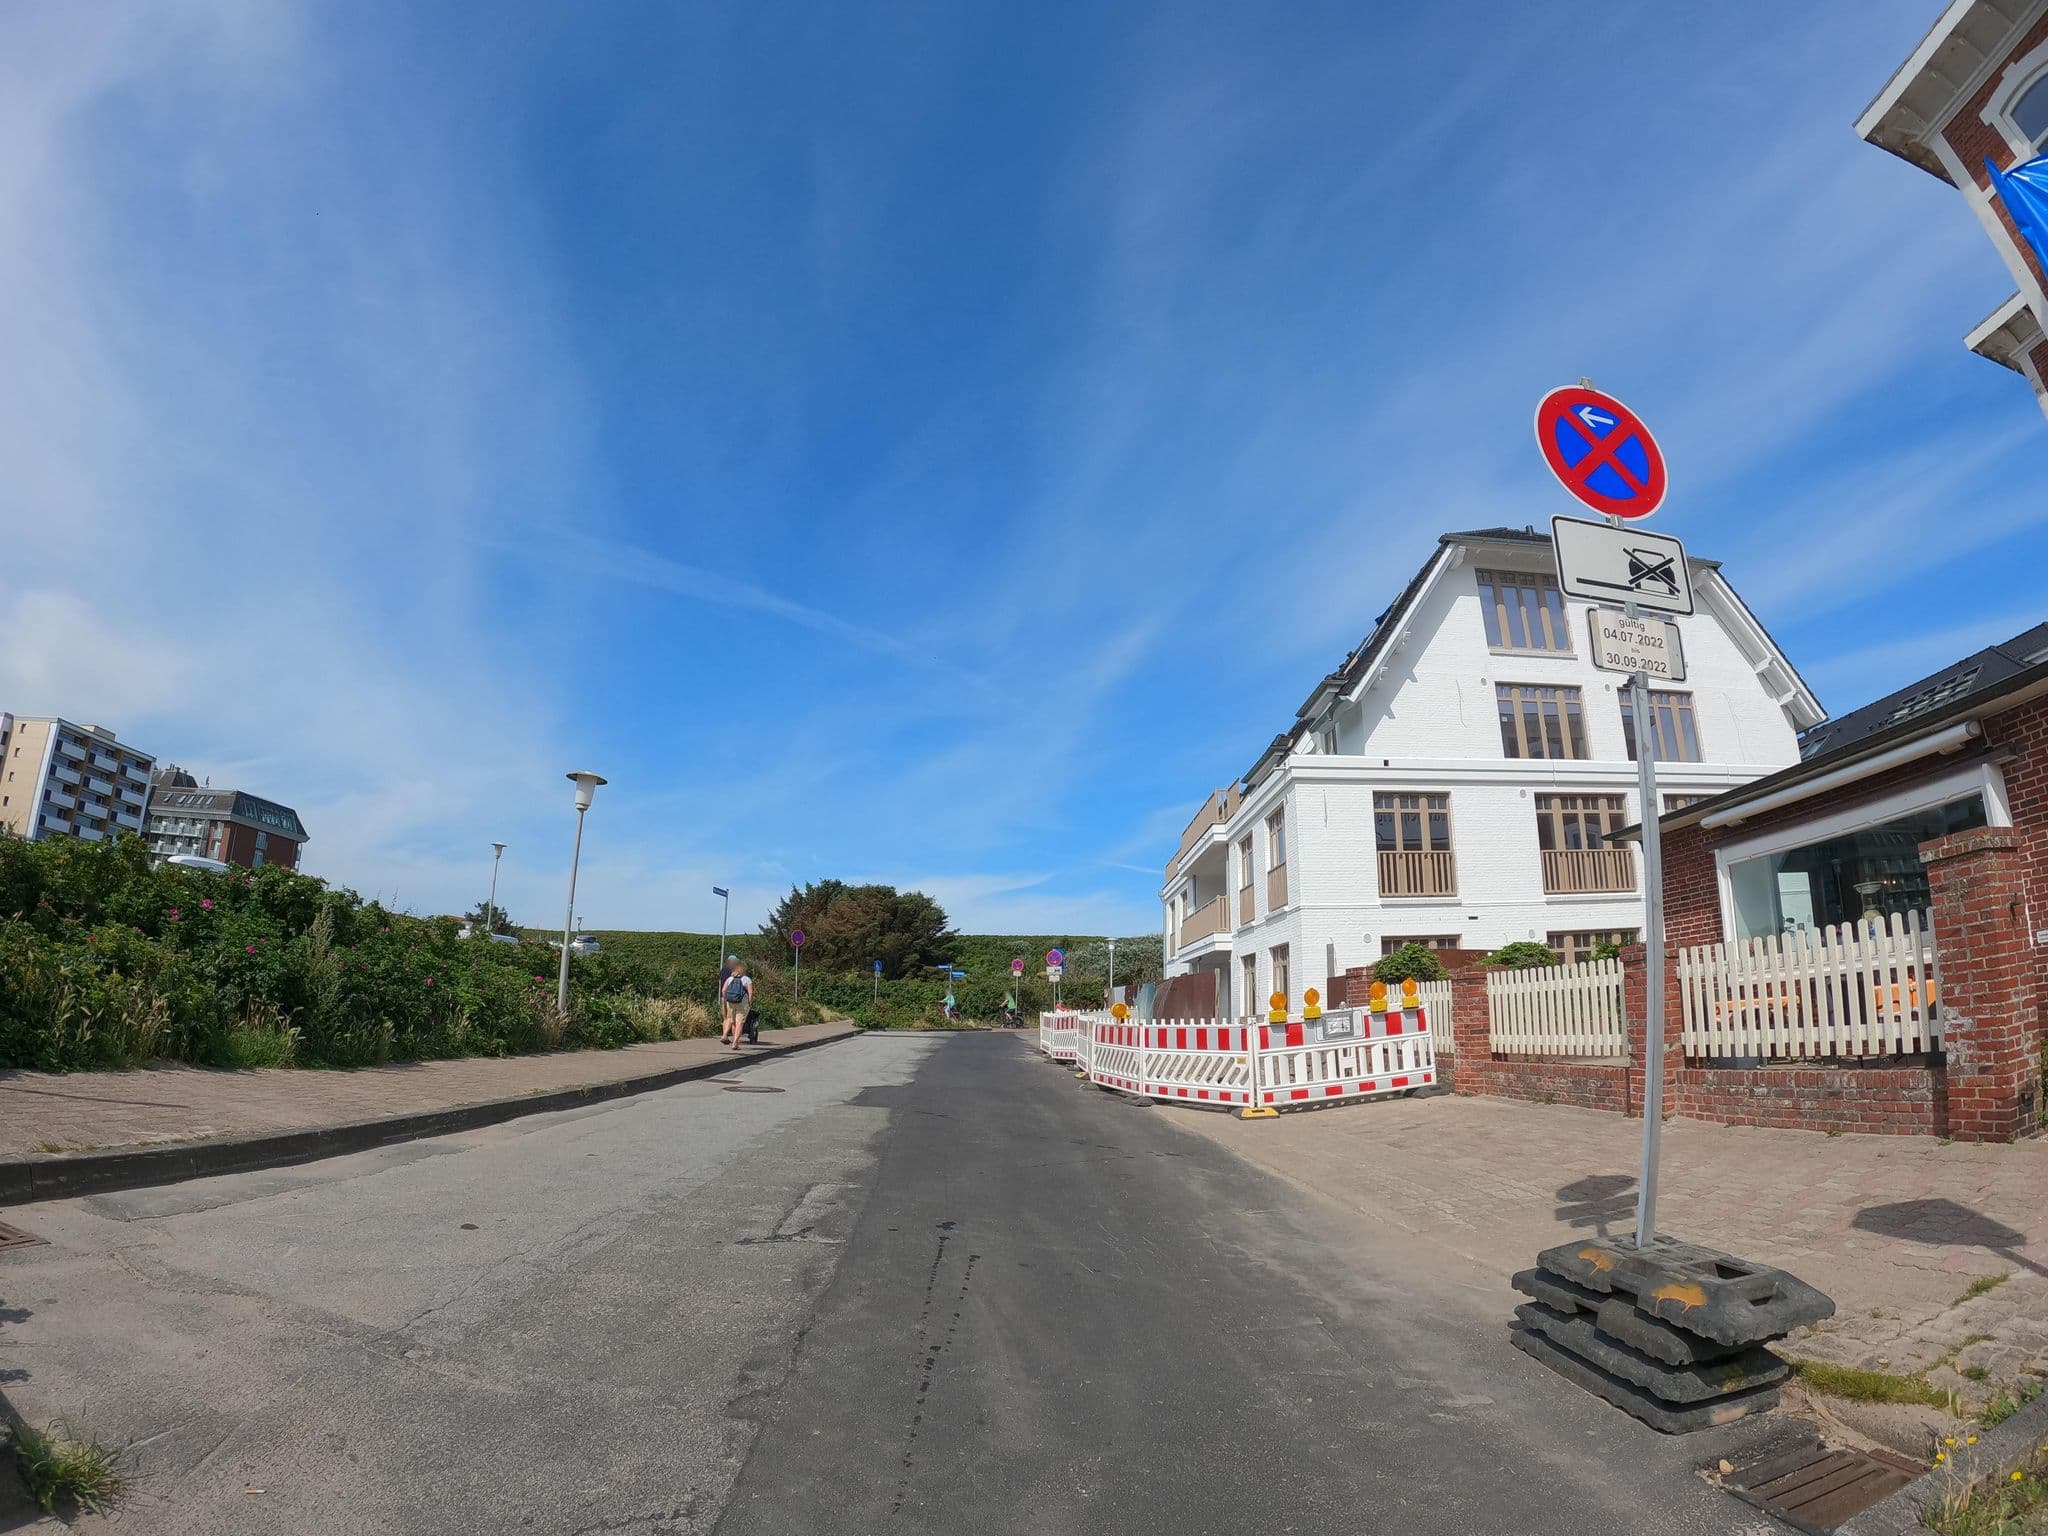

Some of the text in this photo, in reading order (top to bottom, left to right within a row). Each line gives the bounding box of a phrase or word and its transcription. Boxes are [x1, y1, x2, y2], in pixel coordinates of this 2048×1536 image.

[1619, 619, 1645, 632] gültig
[1603, 627, 1664, 649] 04.07.2022
[1606, 652, 1667, 673] 30.09.2022
